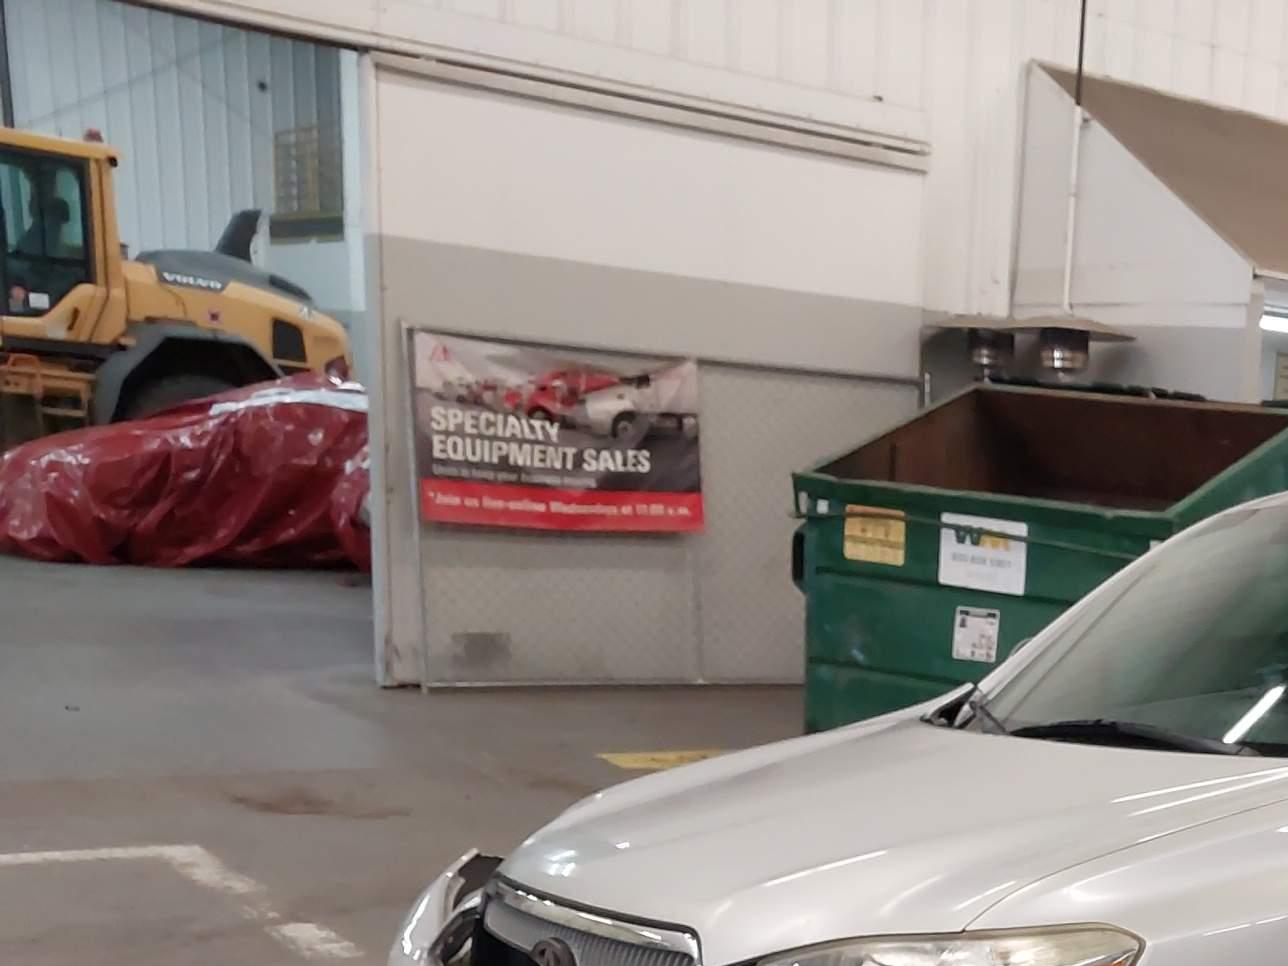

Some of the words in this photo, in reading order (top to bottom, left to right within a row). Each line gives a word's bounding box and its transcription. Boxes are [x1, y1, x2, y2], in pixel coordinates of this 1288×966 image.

[430, 405, 560, 443] SPECIALTY
[432, 434, 577, 471] EQUIPMENT
[582, 447, 652, 474] SALES
